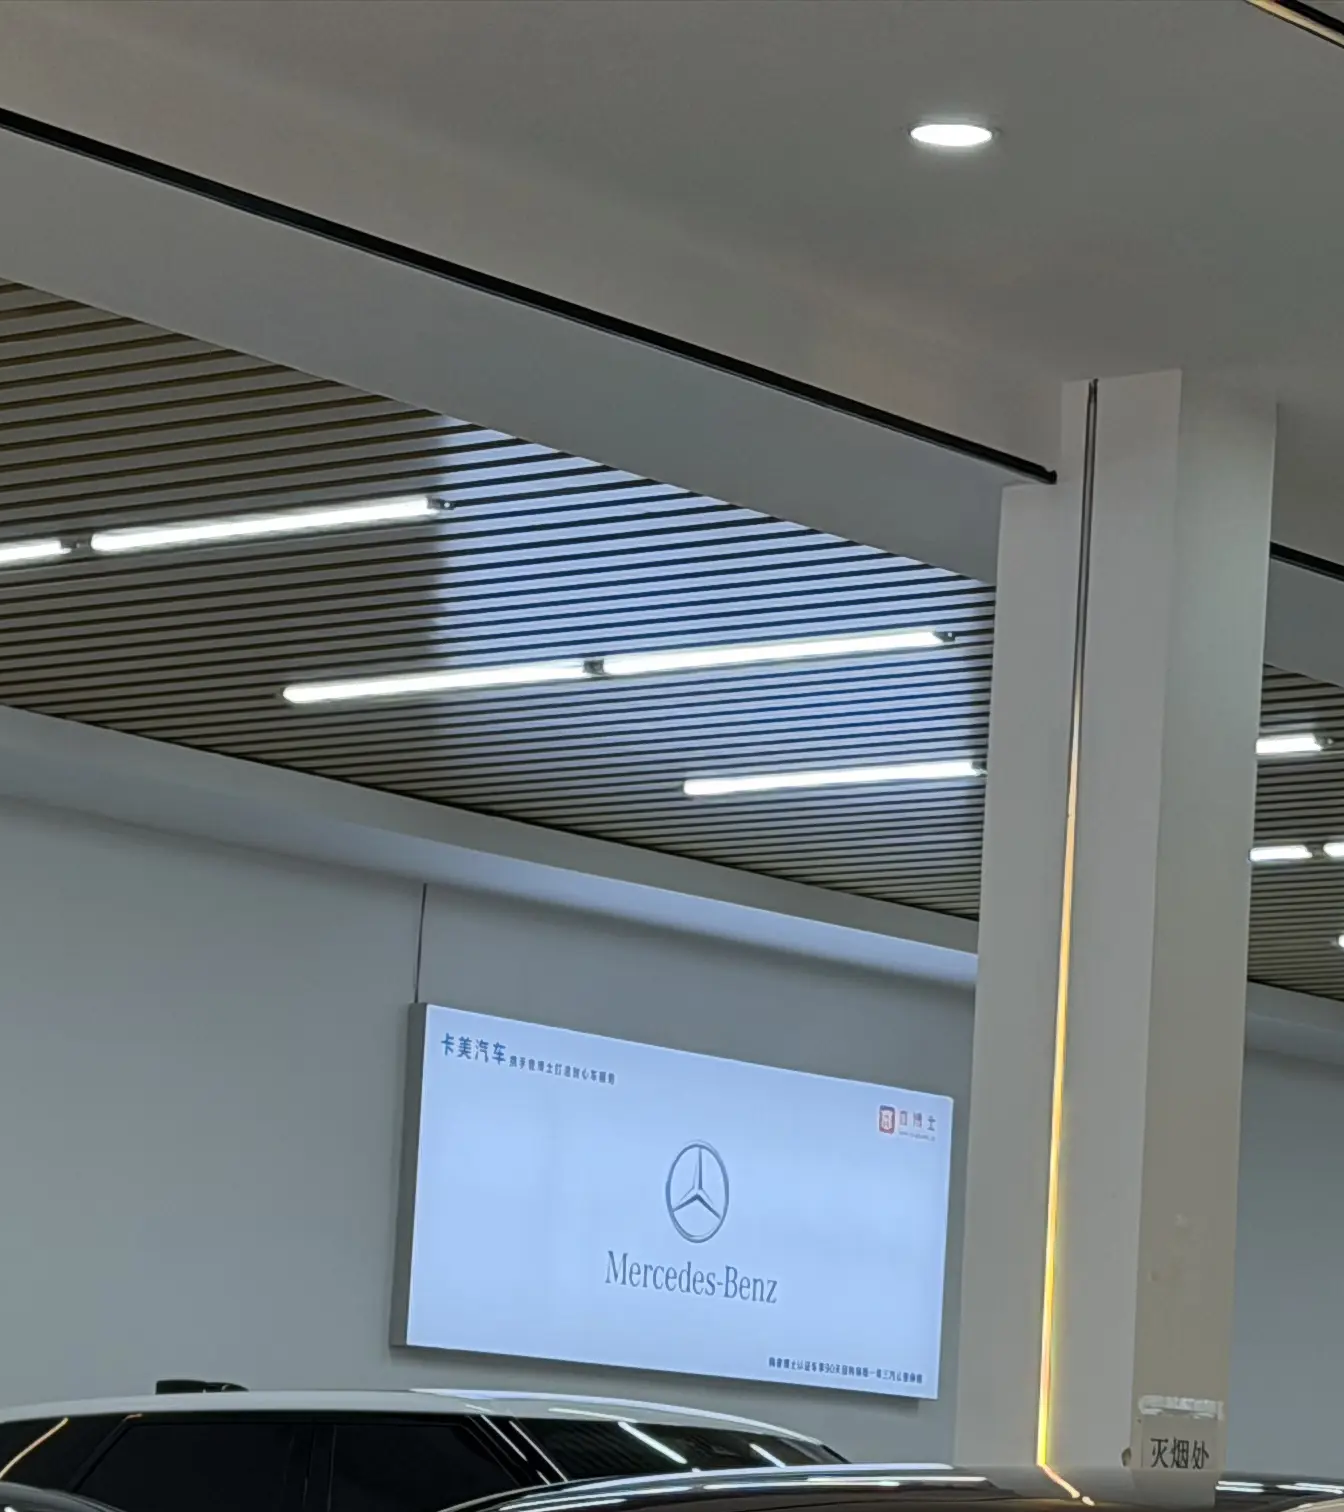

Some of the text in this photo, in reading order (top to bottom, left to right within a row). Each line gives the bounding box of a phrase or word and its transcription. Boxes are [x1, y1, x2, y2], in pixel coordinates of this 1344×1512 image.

[441, 1033, 507, 1066] 卡美汽车
[604, 1249, 778, 1305] Mercedes-Benz
[1150, 1436, 1210, 1470] 灭烟处
